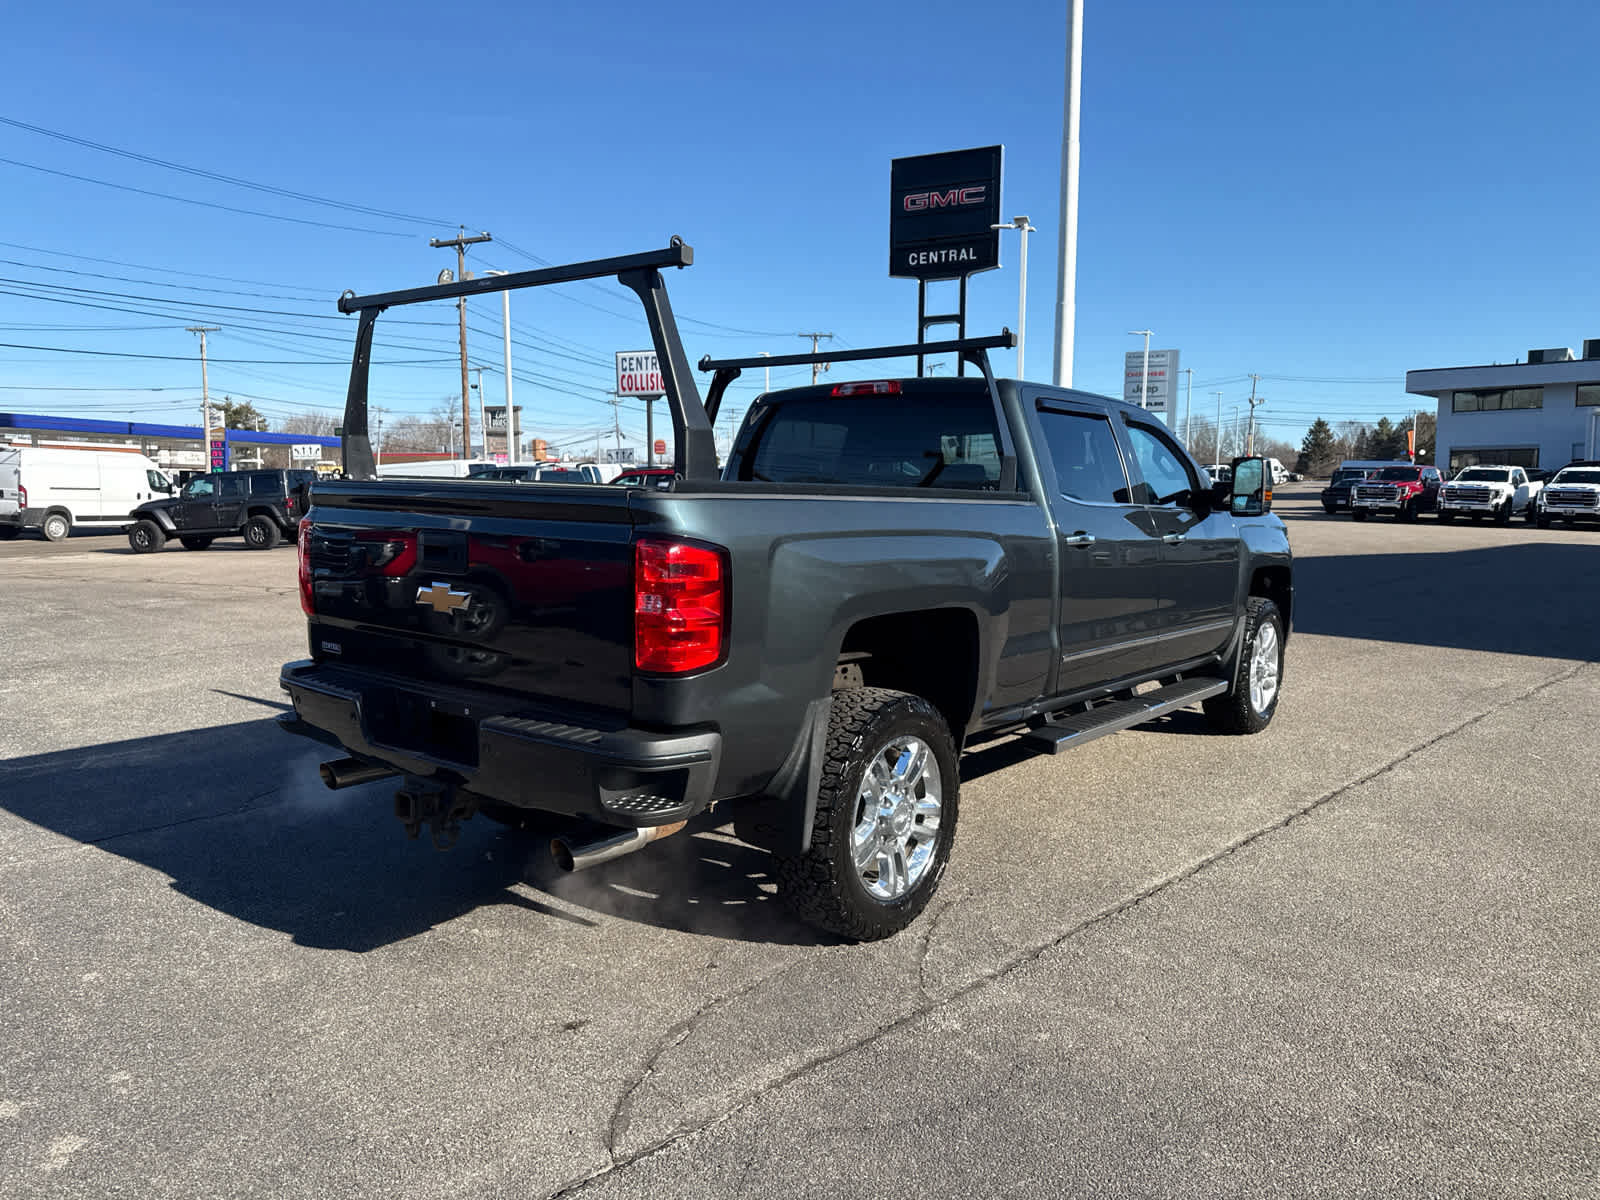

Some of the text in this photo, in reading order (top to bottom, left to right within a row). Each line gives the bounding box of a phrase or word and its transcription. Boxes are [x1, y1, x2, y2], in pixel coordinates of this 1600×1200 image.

[903, 185, 986, 212] GMC
[908, 248, 977, 266] CENTRAL
[621, 356, 660, 372] CENTR
[620, 373, 665, 392] COLLISIO
